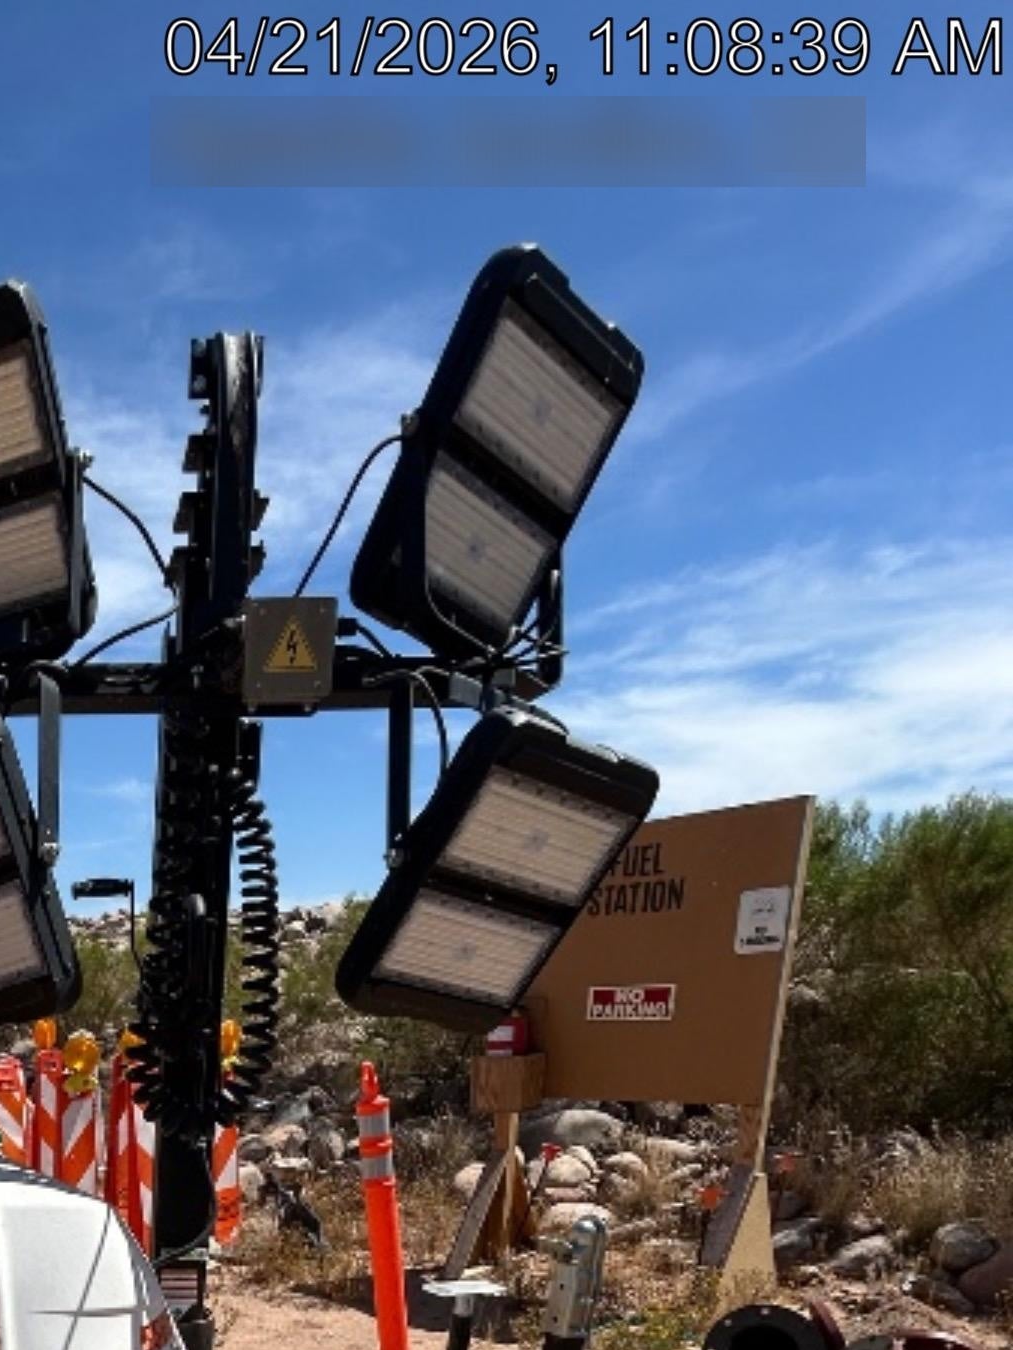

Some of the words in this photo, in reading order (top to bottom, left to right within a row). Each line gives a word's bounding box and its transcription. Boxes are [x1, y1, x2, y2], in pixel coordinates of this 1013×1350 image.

[588, 877, 686, 916] STATION
[614, 988, 646, 1003] NO
[591, 1001, 668, 1019] PARKING
